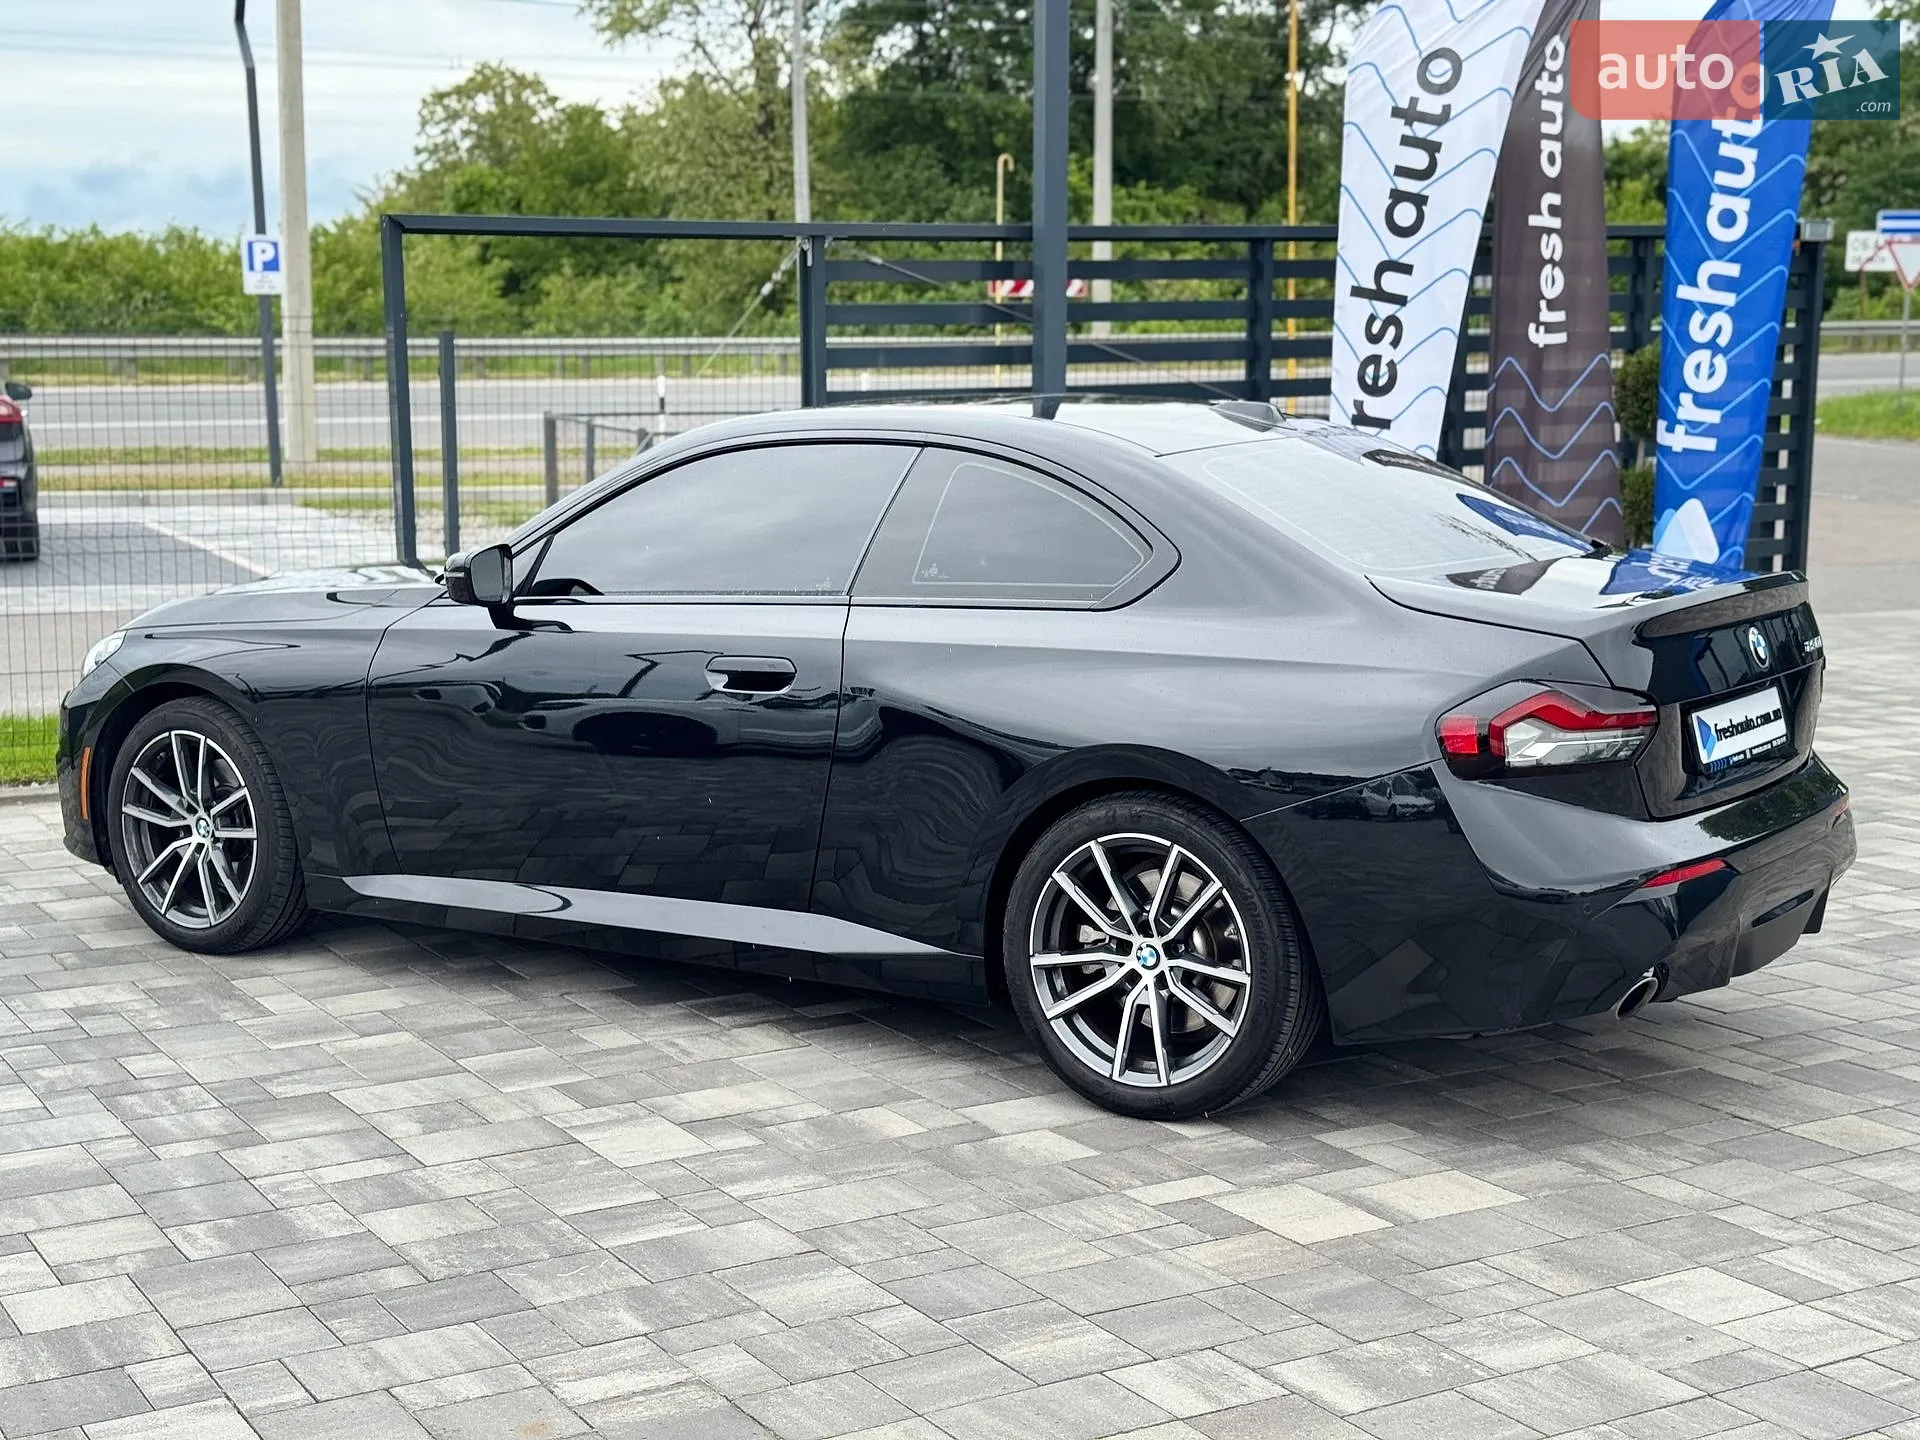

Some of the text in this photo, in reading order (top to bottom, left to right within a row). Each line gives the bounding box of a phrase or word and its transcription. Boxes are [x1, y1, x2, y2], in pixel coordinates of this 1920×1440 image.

[252, 241, 276, 272] P
[1350, 47, 1463, 430] resh auto
[1527, 33, 1568, 349] fresh auto
[1656, 259, 1742, 454] fresh
[1714, 708, 1783, 742] freshauto.com.ua
